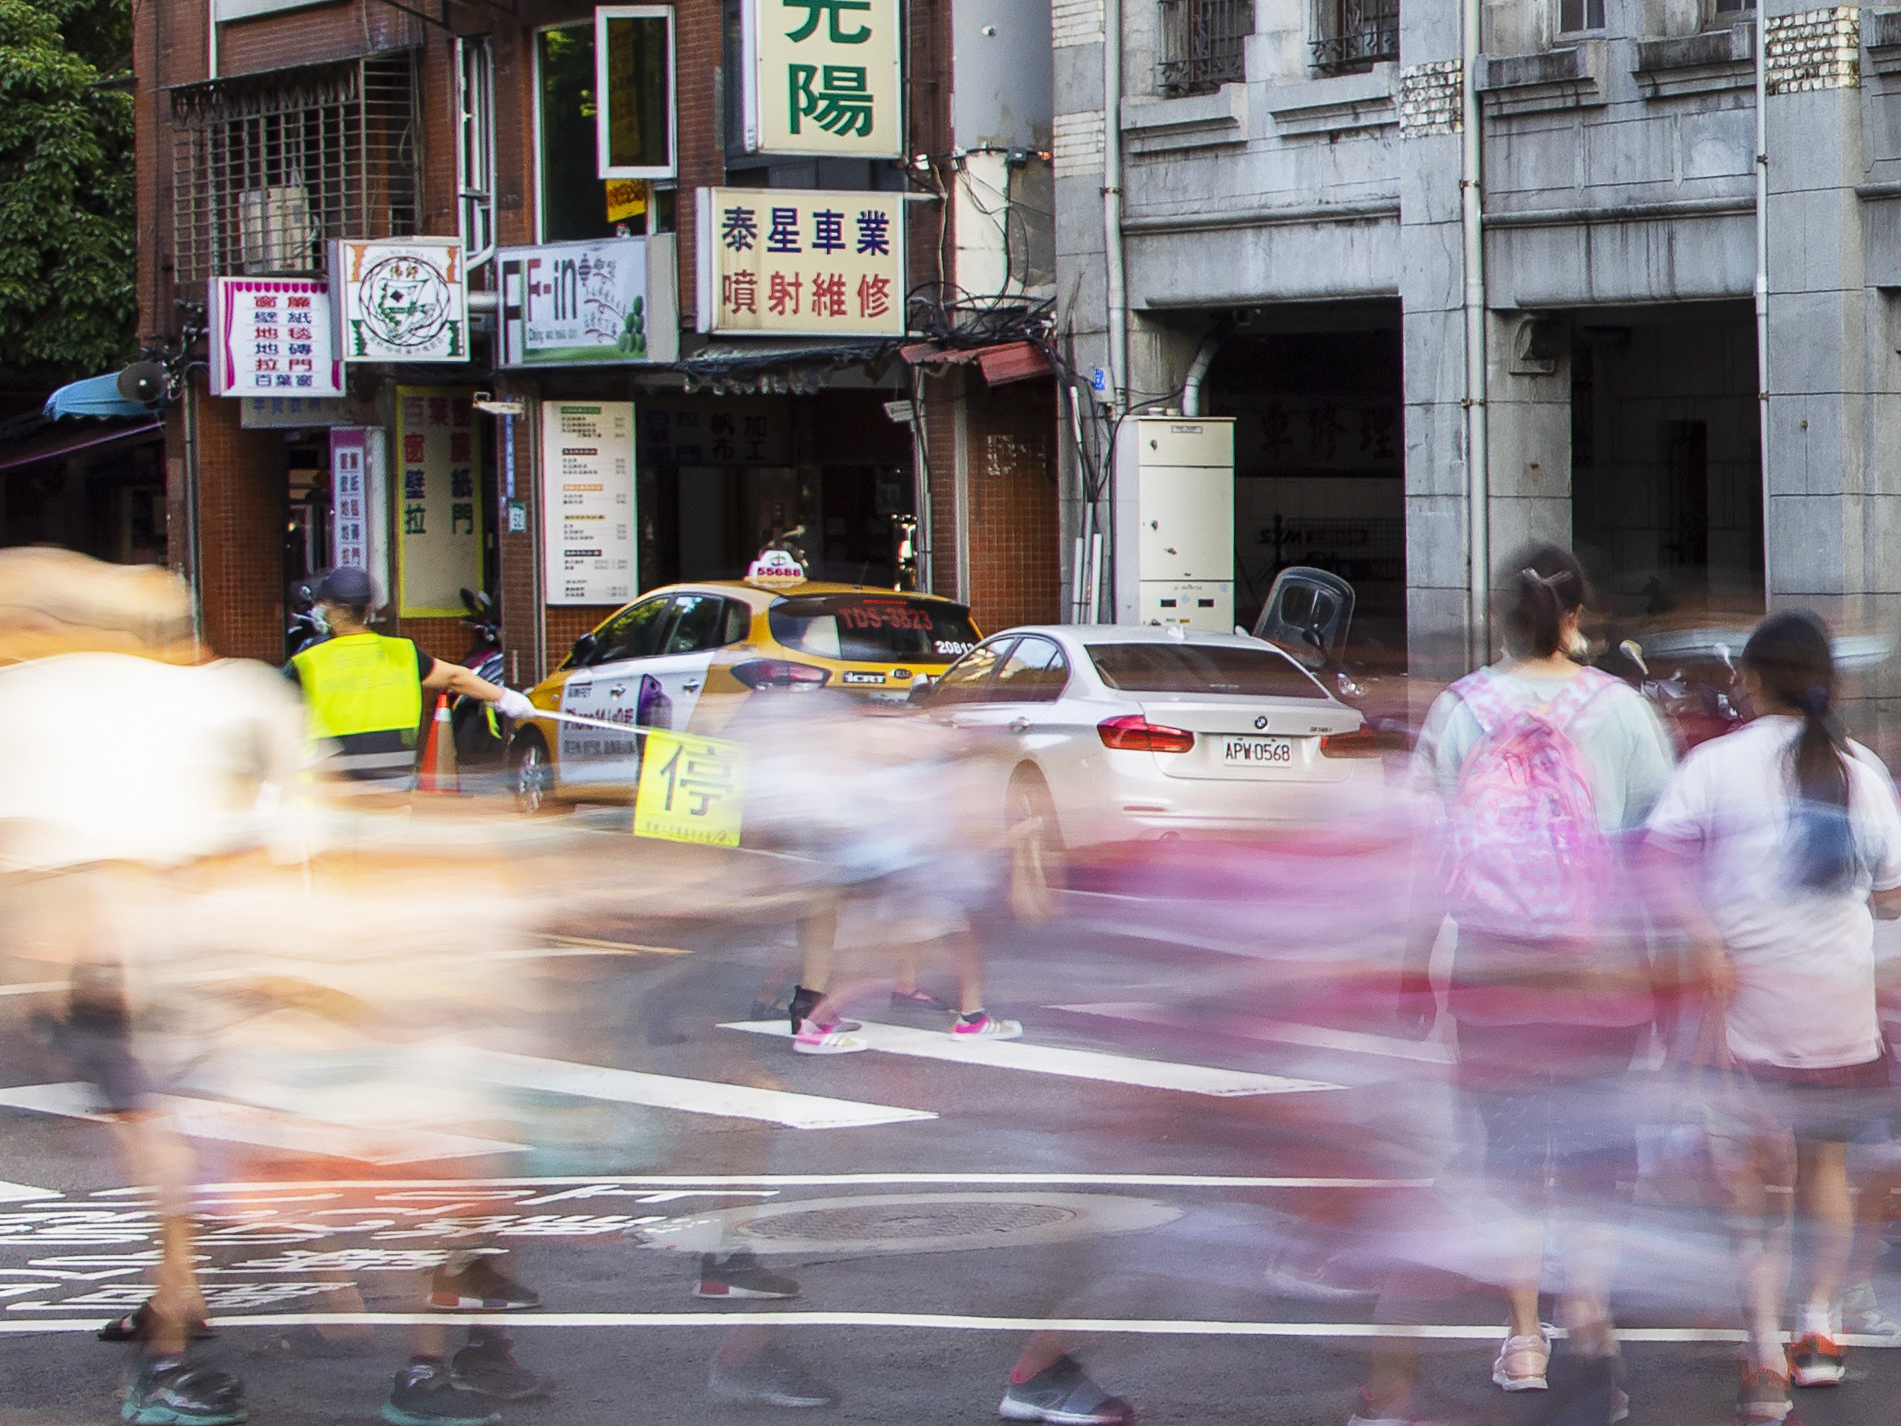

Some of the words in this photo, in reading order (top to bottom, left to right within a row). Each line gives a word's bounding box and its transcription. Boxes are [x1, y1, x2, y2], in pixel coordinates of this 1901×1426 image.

[721, 206, 890, 255] 泰星車業
[721, 271, 891, 319] 噴射維修
[757, 567, 801, 577] 55688
[1225, 742, 1291, 762] APW-0568
[660, 742, 734, 816] 停
